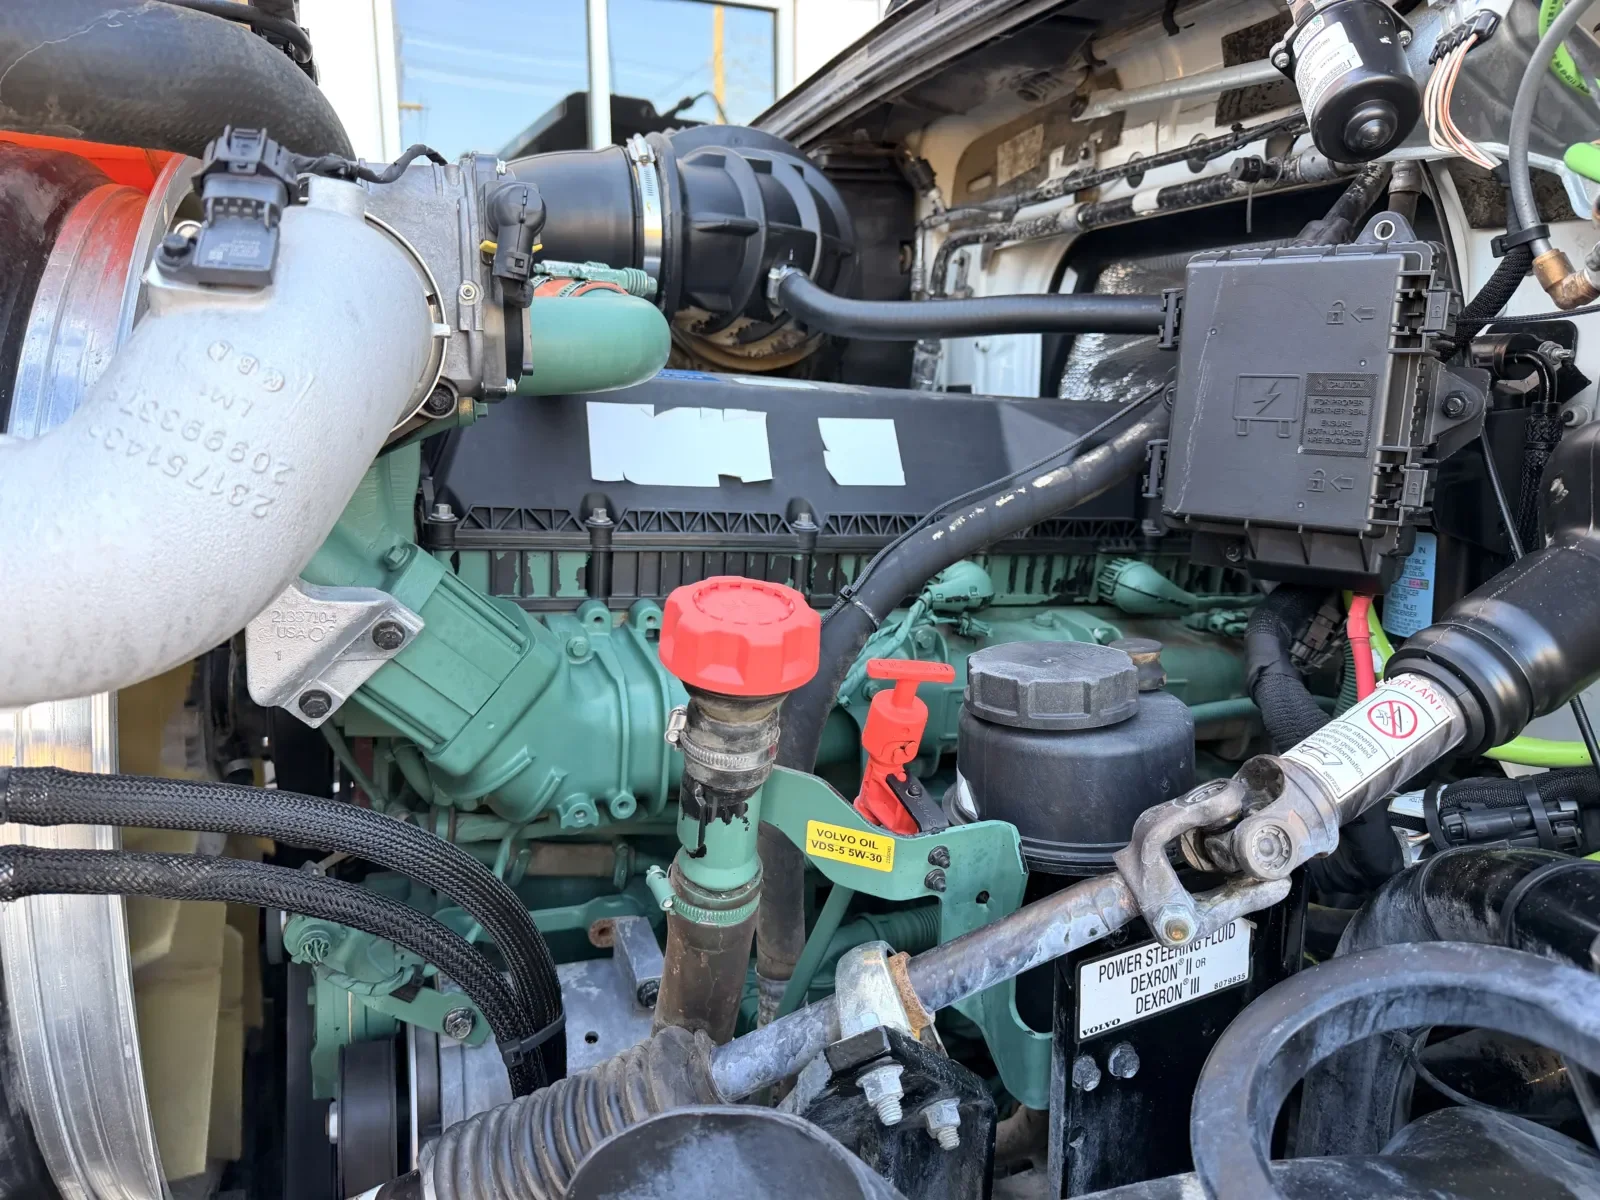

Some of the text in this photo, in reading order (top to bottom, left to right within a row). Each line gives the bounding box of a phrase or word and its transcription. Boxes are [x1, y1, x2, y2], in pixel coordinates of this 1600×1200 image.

[1328, 381, 1363, 389] CAUTION
[1306, 428, 1364, 437] BOTH LATCHES
[1320, 420, 1353, 428] ENSURE
[1324, 438, 1362, 446] ENGAGED
[272, 610, 336, 624] 21337104
[277, 626, 306, 638] USA
[816, 828, 878, 850] VOLVO OIL
[812, 840, 845, 854] VDS-5
[848, 848, 882, 863] 5W-30
[1099, 950, 1142, 983] POWER
[1204, 922, 1236, 948] FLUID
[1186, 958, 1192, 976] II
[1196, 957, 1206, 969] OR
[1190, 976, 1200, 995] III
[1214, 972, 1246, 990] 8079835
[1082, 1018, 1121, 1036] VOLVO
